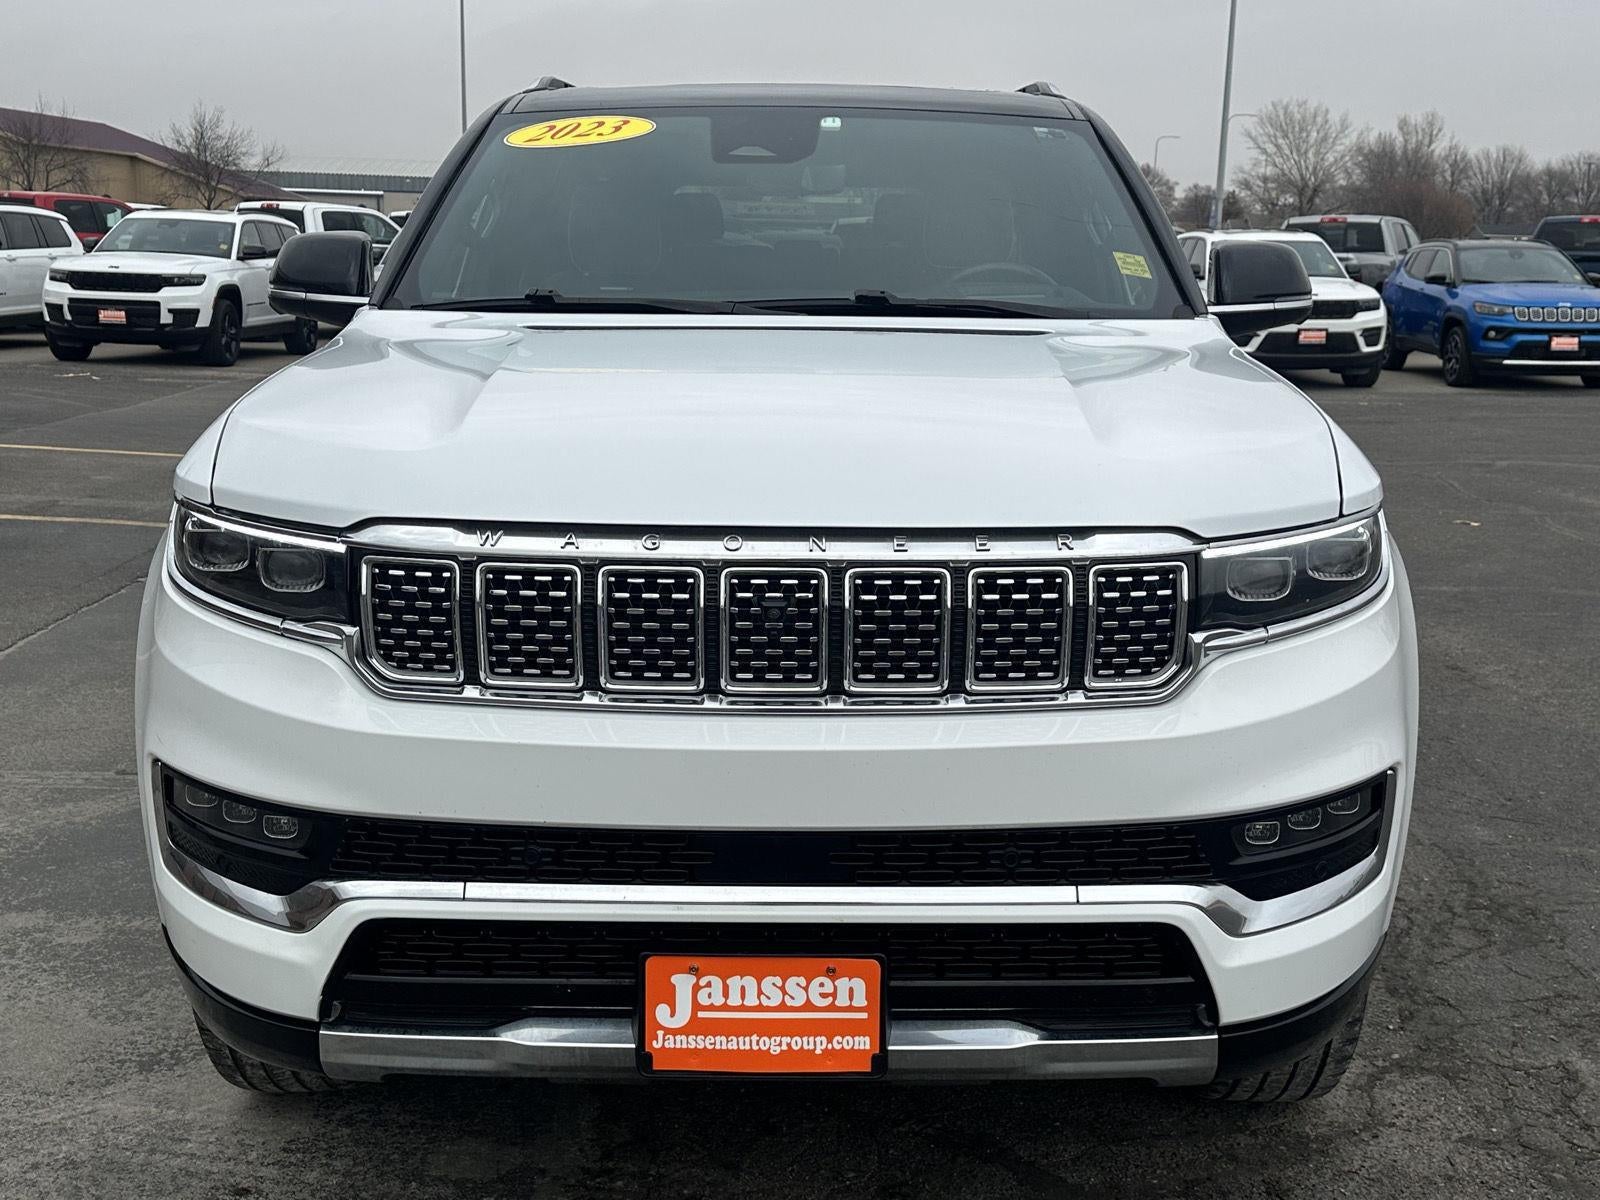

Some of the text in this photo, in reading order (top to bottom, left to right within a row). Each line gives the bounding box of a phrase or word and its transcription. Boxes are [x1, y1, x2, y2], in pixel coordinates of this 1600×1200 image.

[523, 119, 631, 143] 2023
[476, 529, 1075, 552] WAGONEER
[655, 973, 868, 1029] Janssen
[652, 1030, 870, 1055] Janssenautogroup.com
